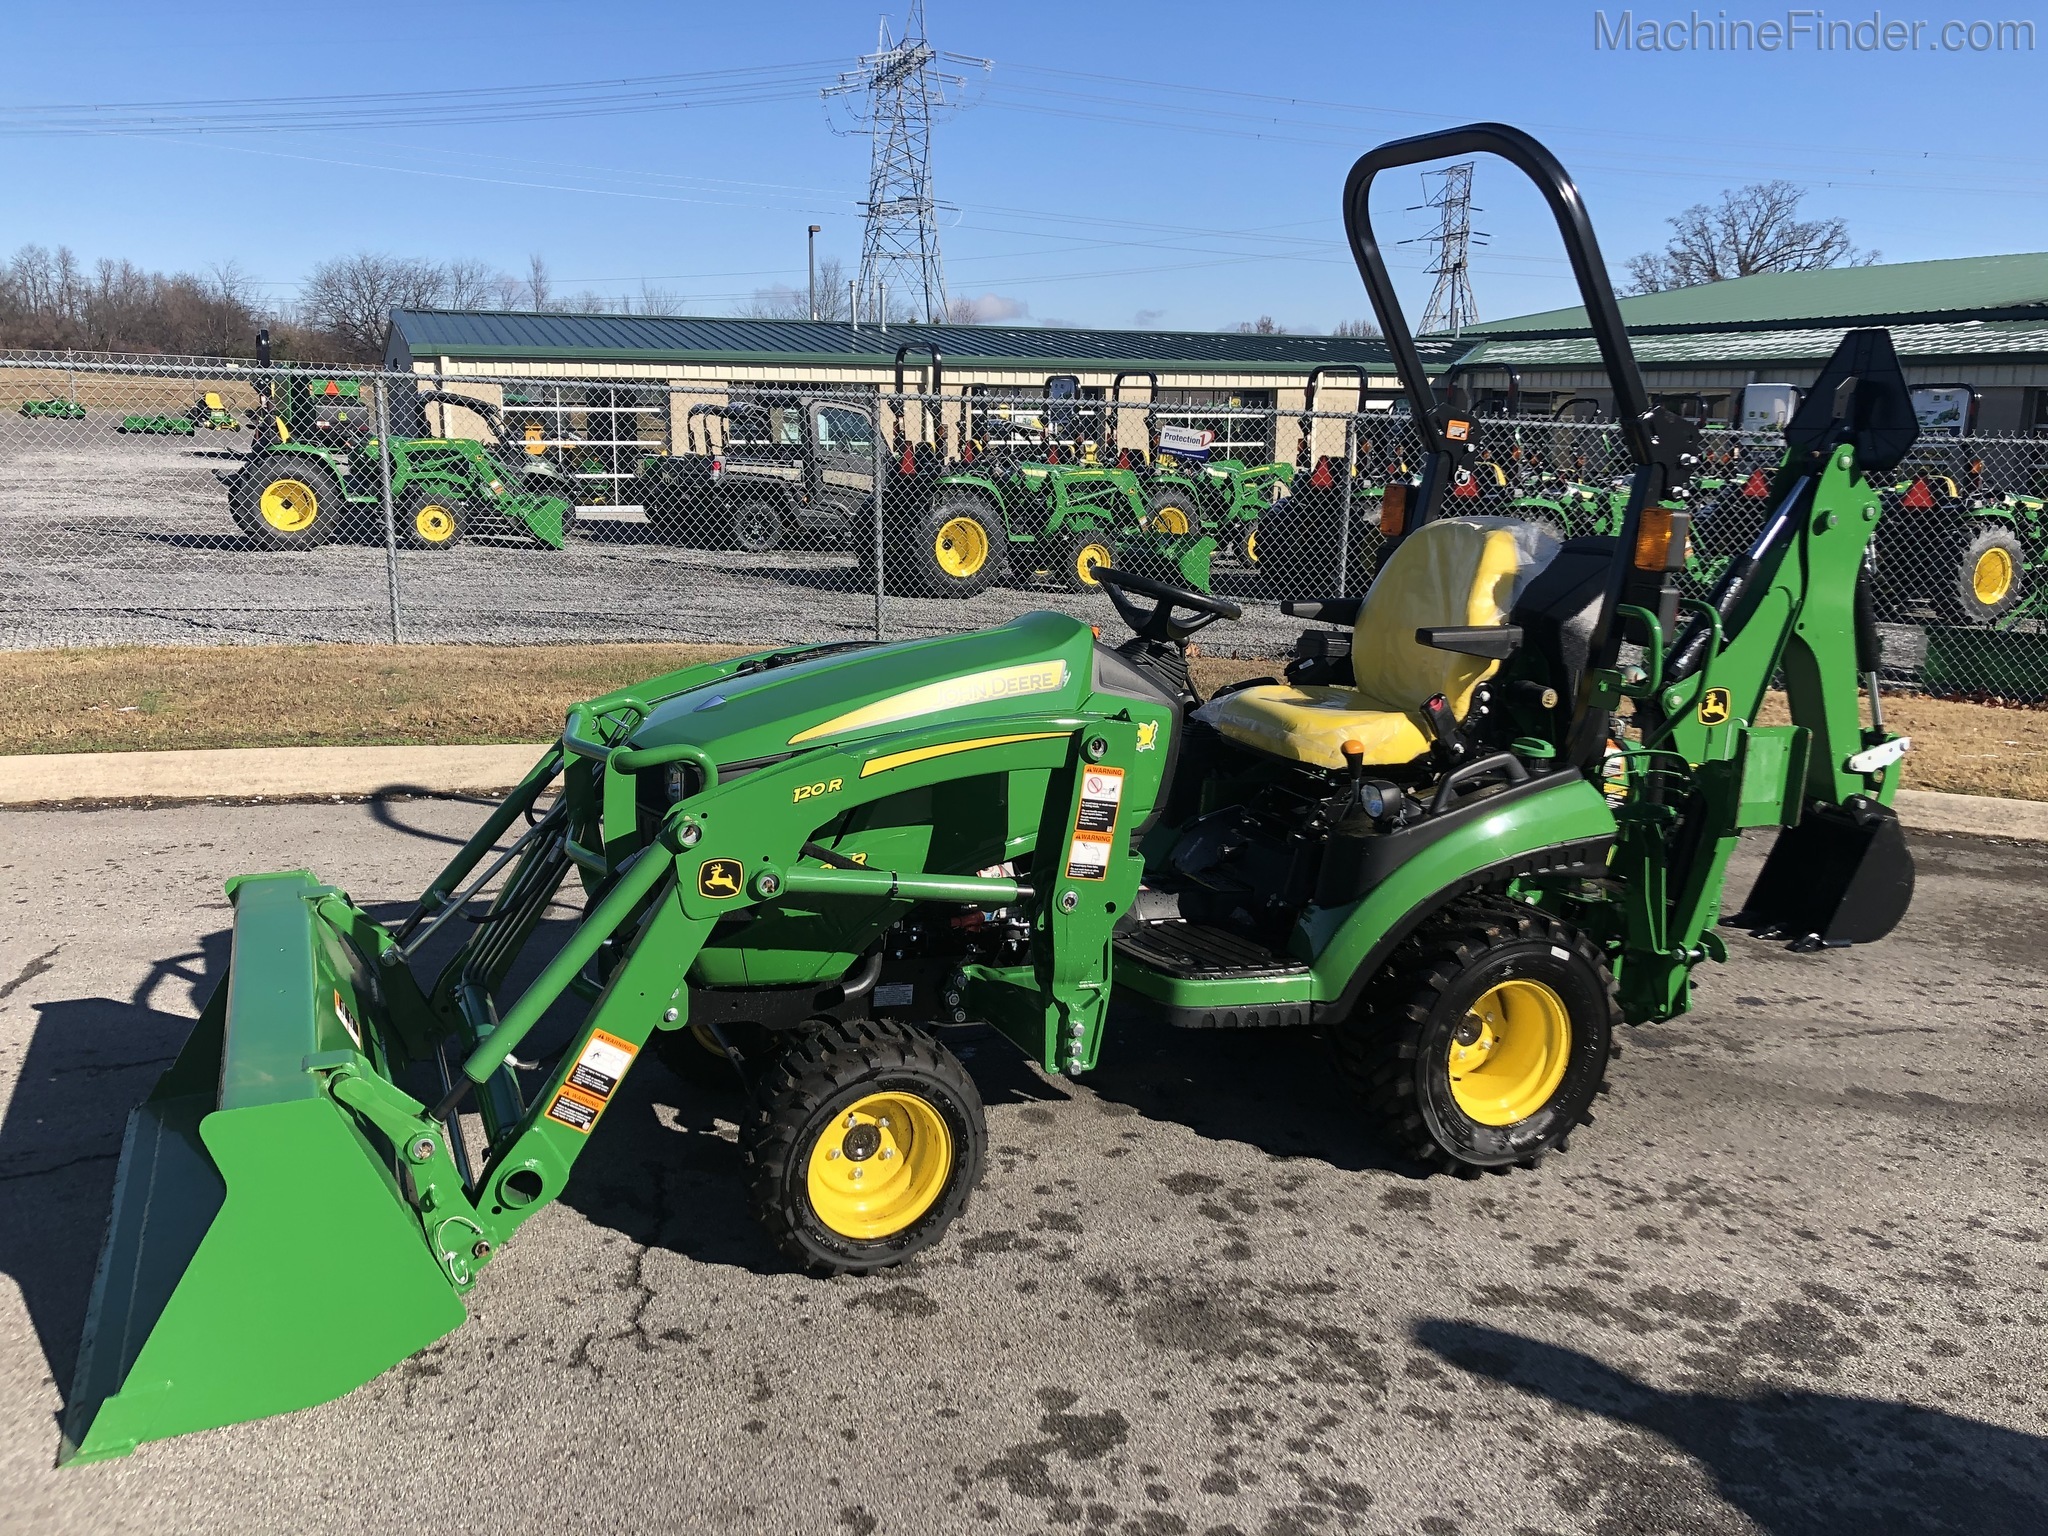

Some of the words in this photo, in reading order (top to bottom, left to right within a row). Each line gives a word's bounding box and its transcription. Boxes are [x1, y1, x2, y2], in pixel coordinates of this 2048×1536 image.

[936, 679, 988, 706] JOHN
[992, 672, 1053, 695] DEERE
[1092, 767, 1122, 776] WARNING
[1081, 834, 1111, 843] WARNING
[604, 1036, 632, 1052] WARNING
[571, 1093, 599, 1108] WARNING
